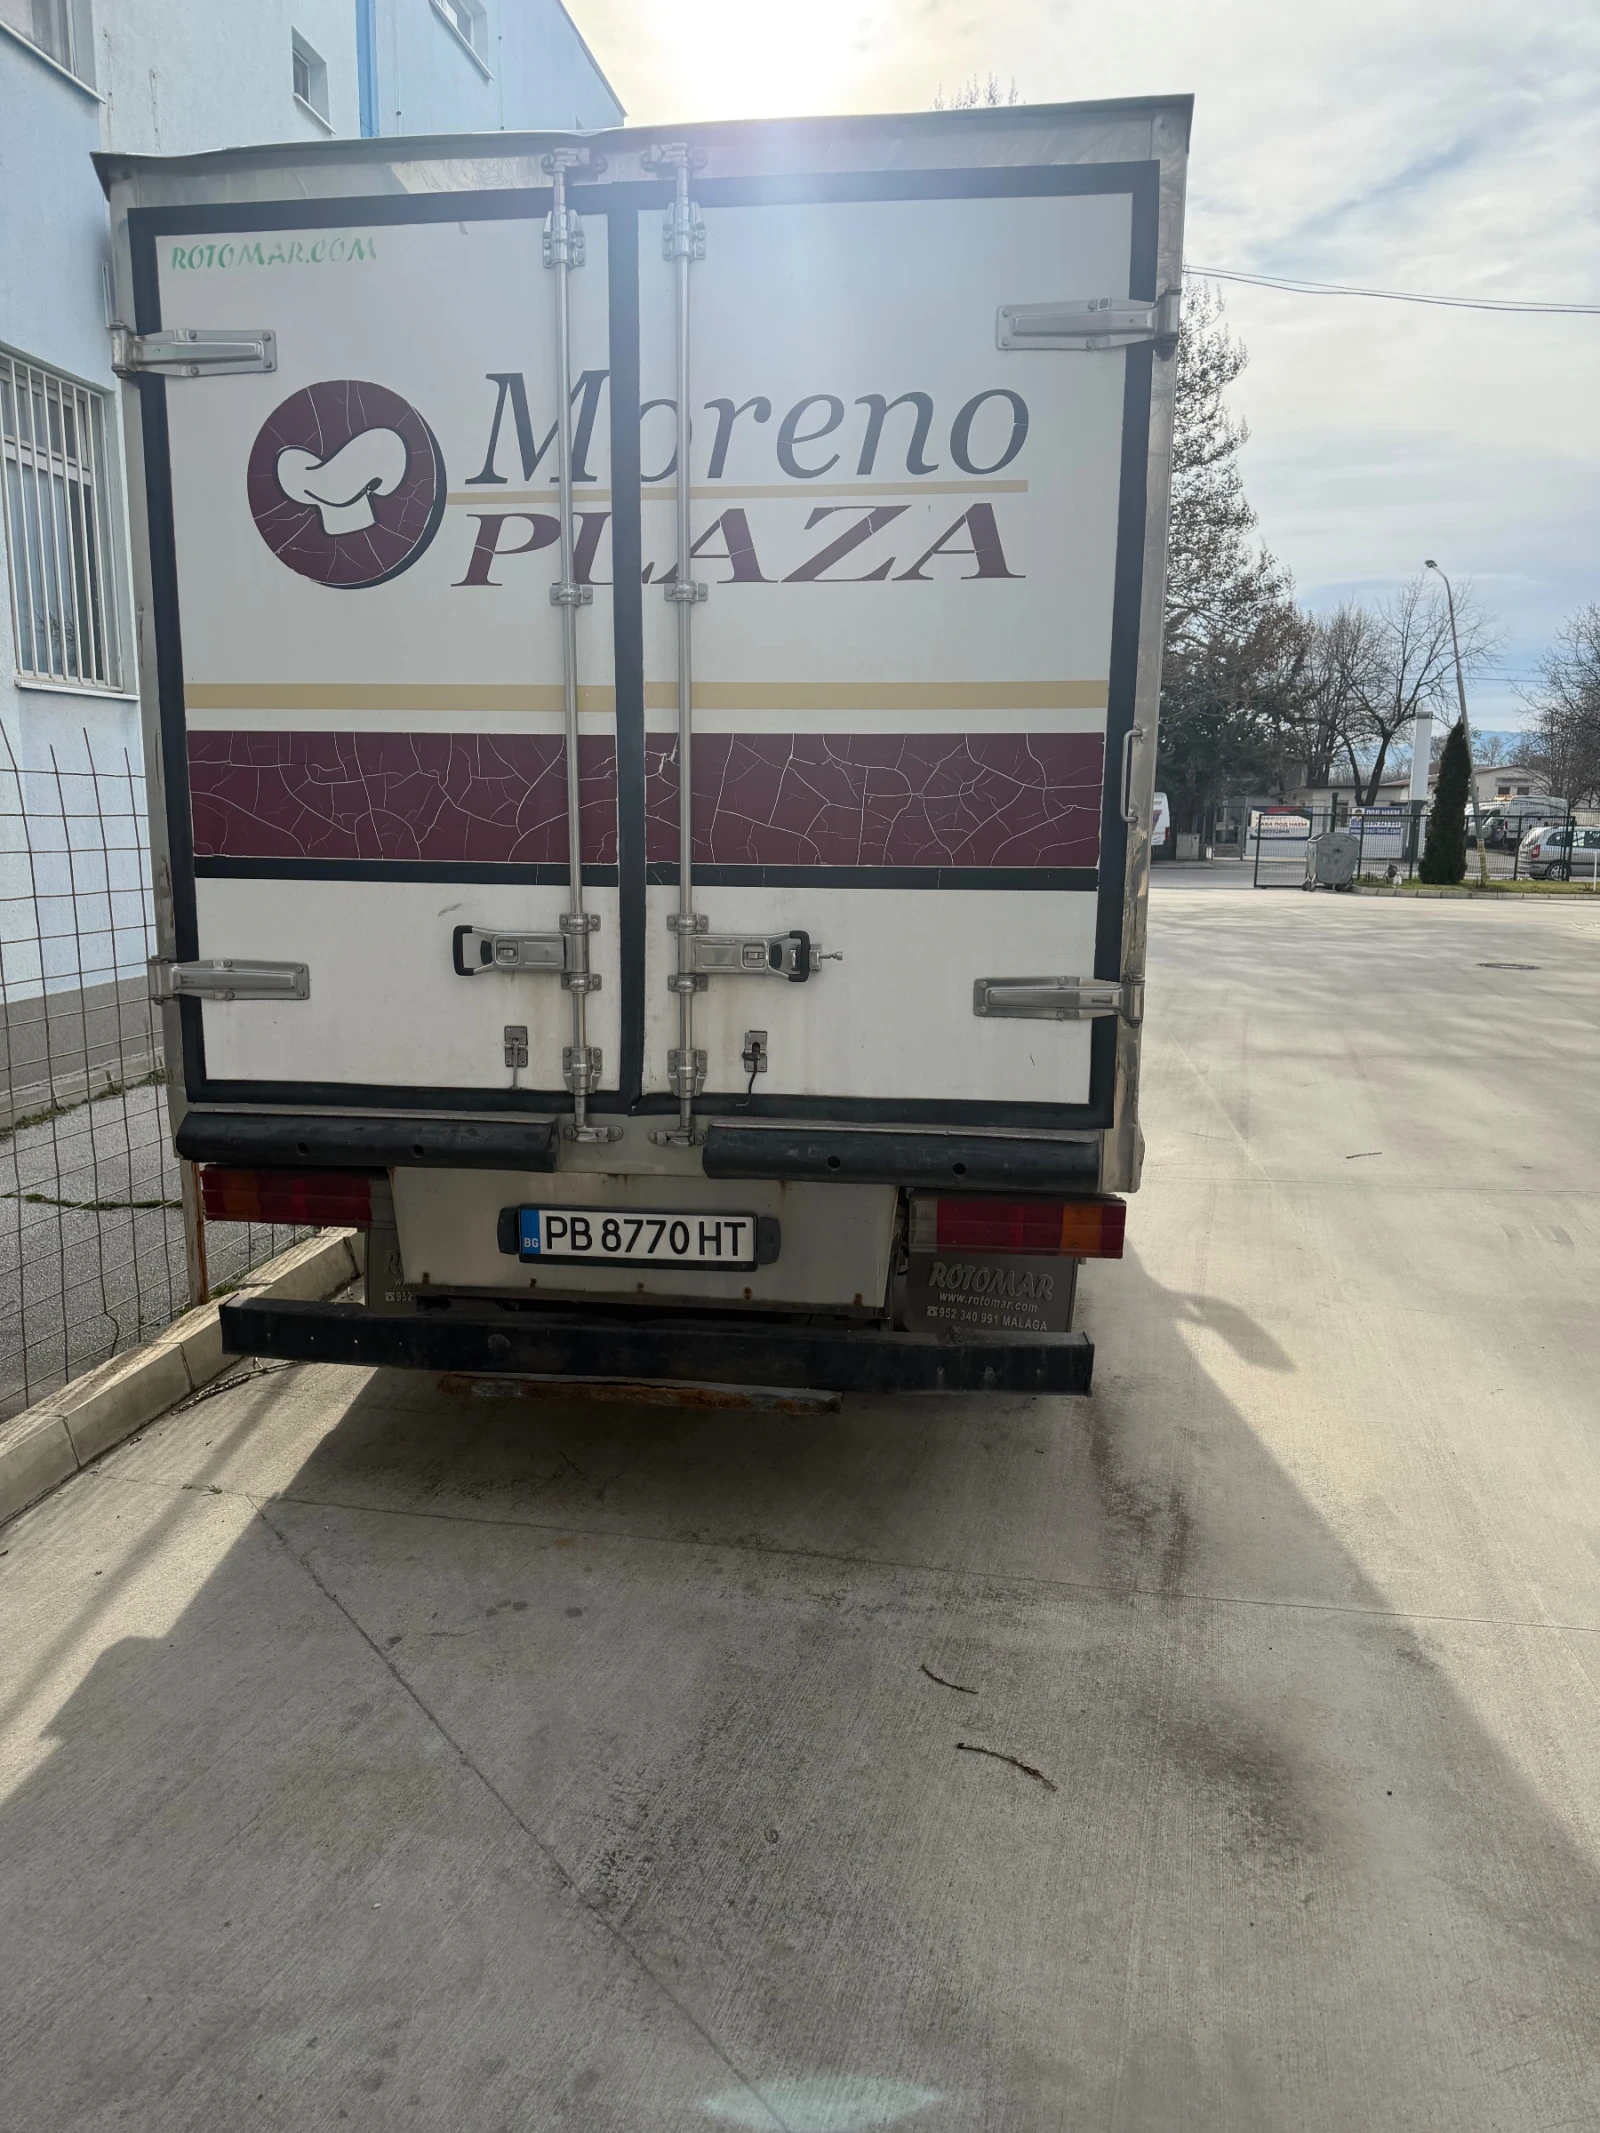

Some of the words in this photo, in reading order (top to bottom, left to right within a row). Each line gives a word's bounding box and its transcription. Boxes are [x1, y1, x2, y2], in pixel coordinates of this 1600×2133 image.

[170, 236, 377, 271] ROTOMAR.COM
[464, 368, 1030, 484] Moreno
[450, 501, 1027, 588] PLAZA
[523, 1237, 540, 1249] BG
[545, 1215, 593, 1251] PB
[601, 1218, 690, 1255] 8770
[698, 1220, 747, 1257] HT
[928, 1261, 1054, 1301] ROTOMAR
[938, 1305, 957, 1319] 952
[960, 1308, 978, 1323] 340
[980, 1311, 999, 1326] 991
[1002, 1313, 1048, 1332] MÁLAGA
[939, 1291, 1038, 1314] www.rotomar.com
